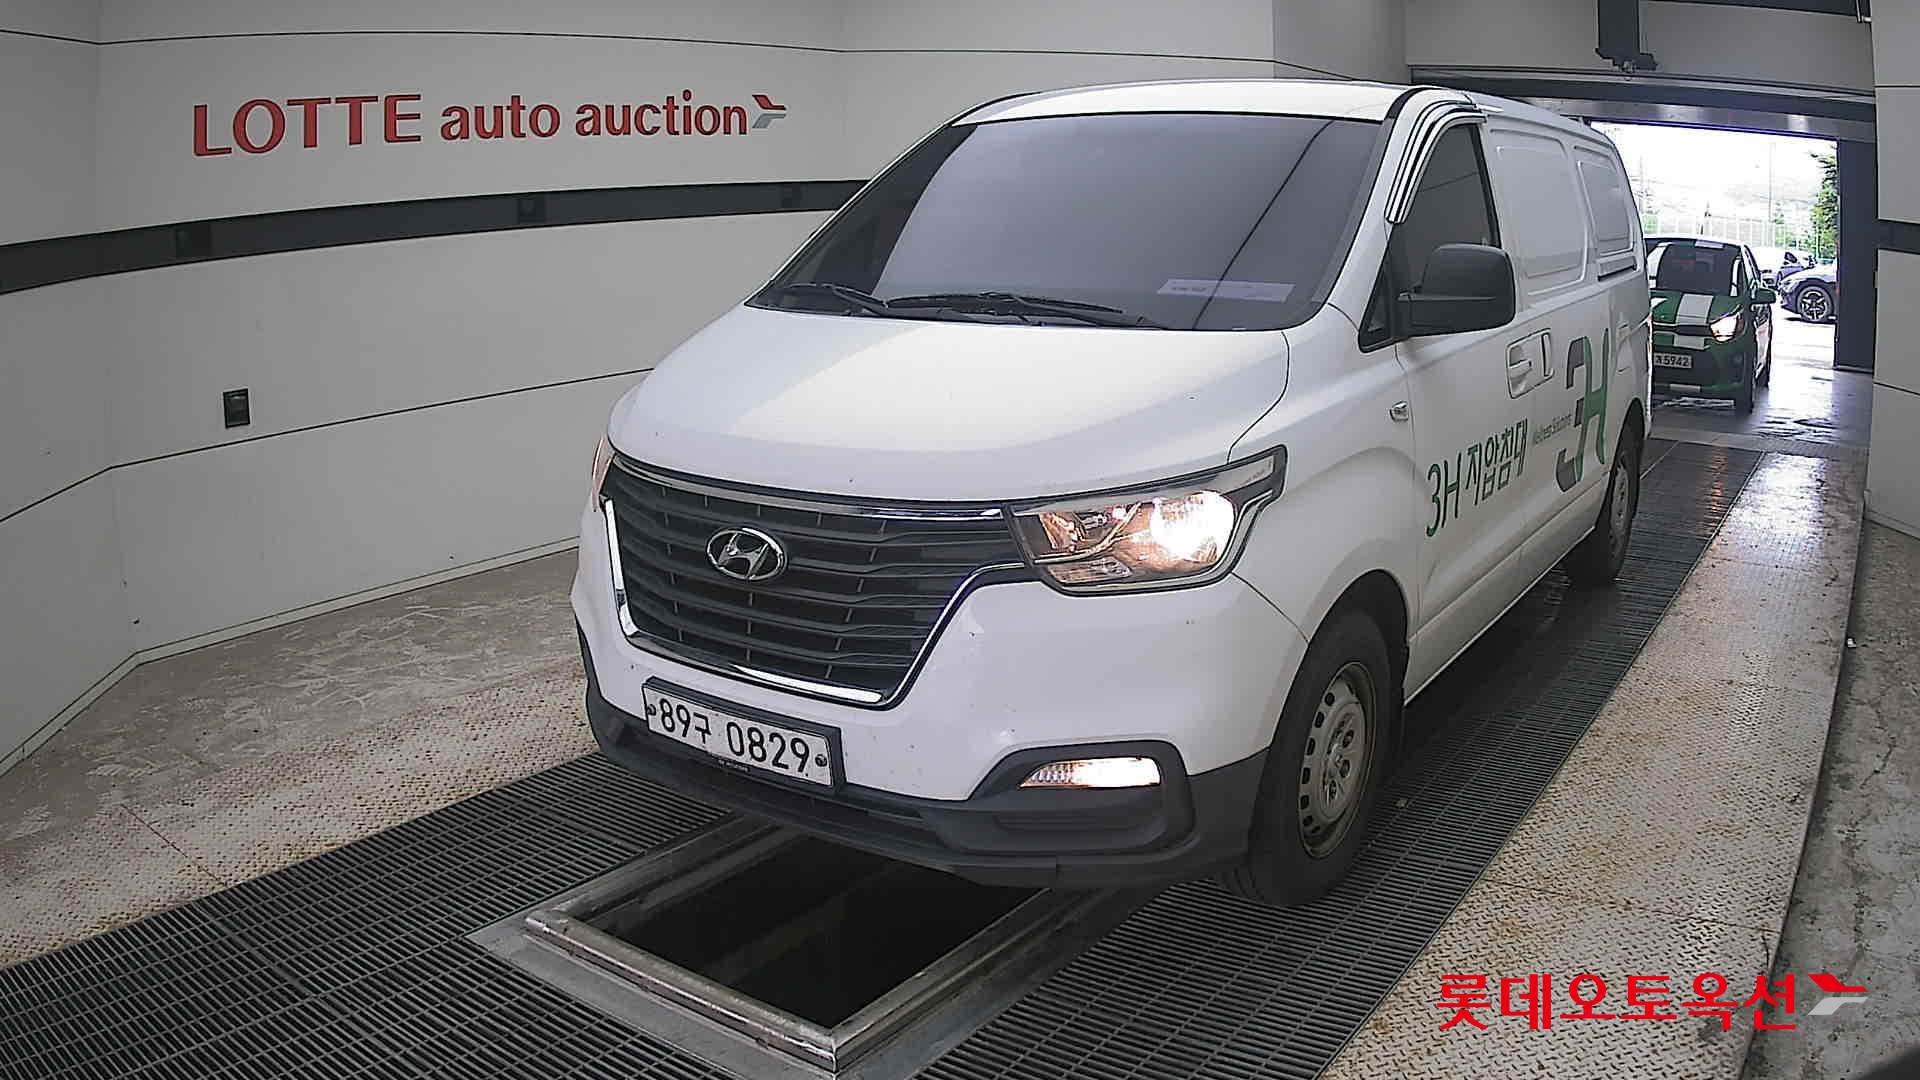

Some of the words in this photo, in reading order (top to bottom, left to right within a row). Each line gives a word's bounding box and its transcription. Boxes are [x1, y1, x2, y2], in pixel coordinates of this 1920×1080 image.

[192, 93, 423, 157] LOTTE
[440, 94, 561, 141] auto
[575, 88, 748, 137] auction
[1426, 452, 1462, 537] 3H
[1465, 418, 1528, 506] 지압침대
[726, 721, 810, 773] 0829
